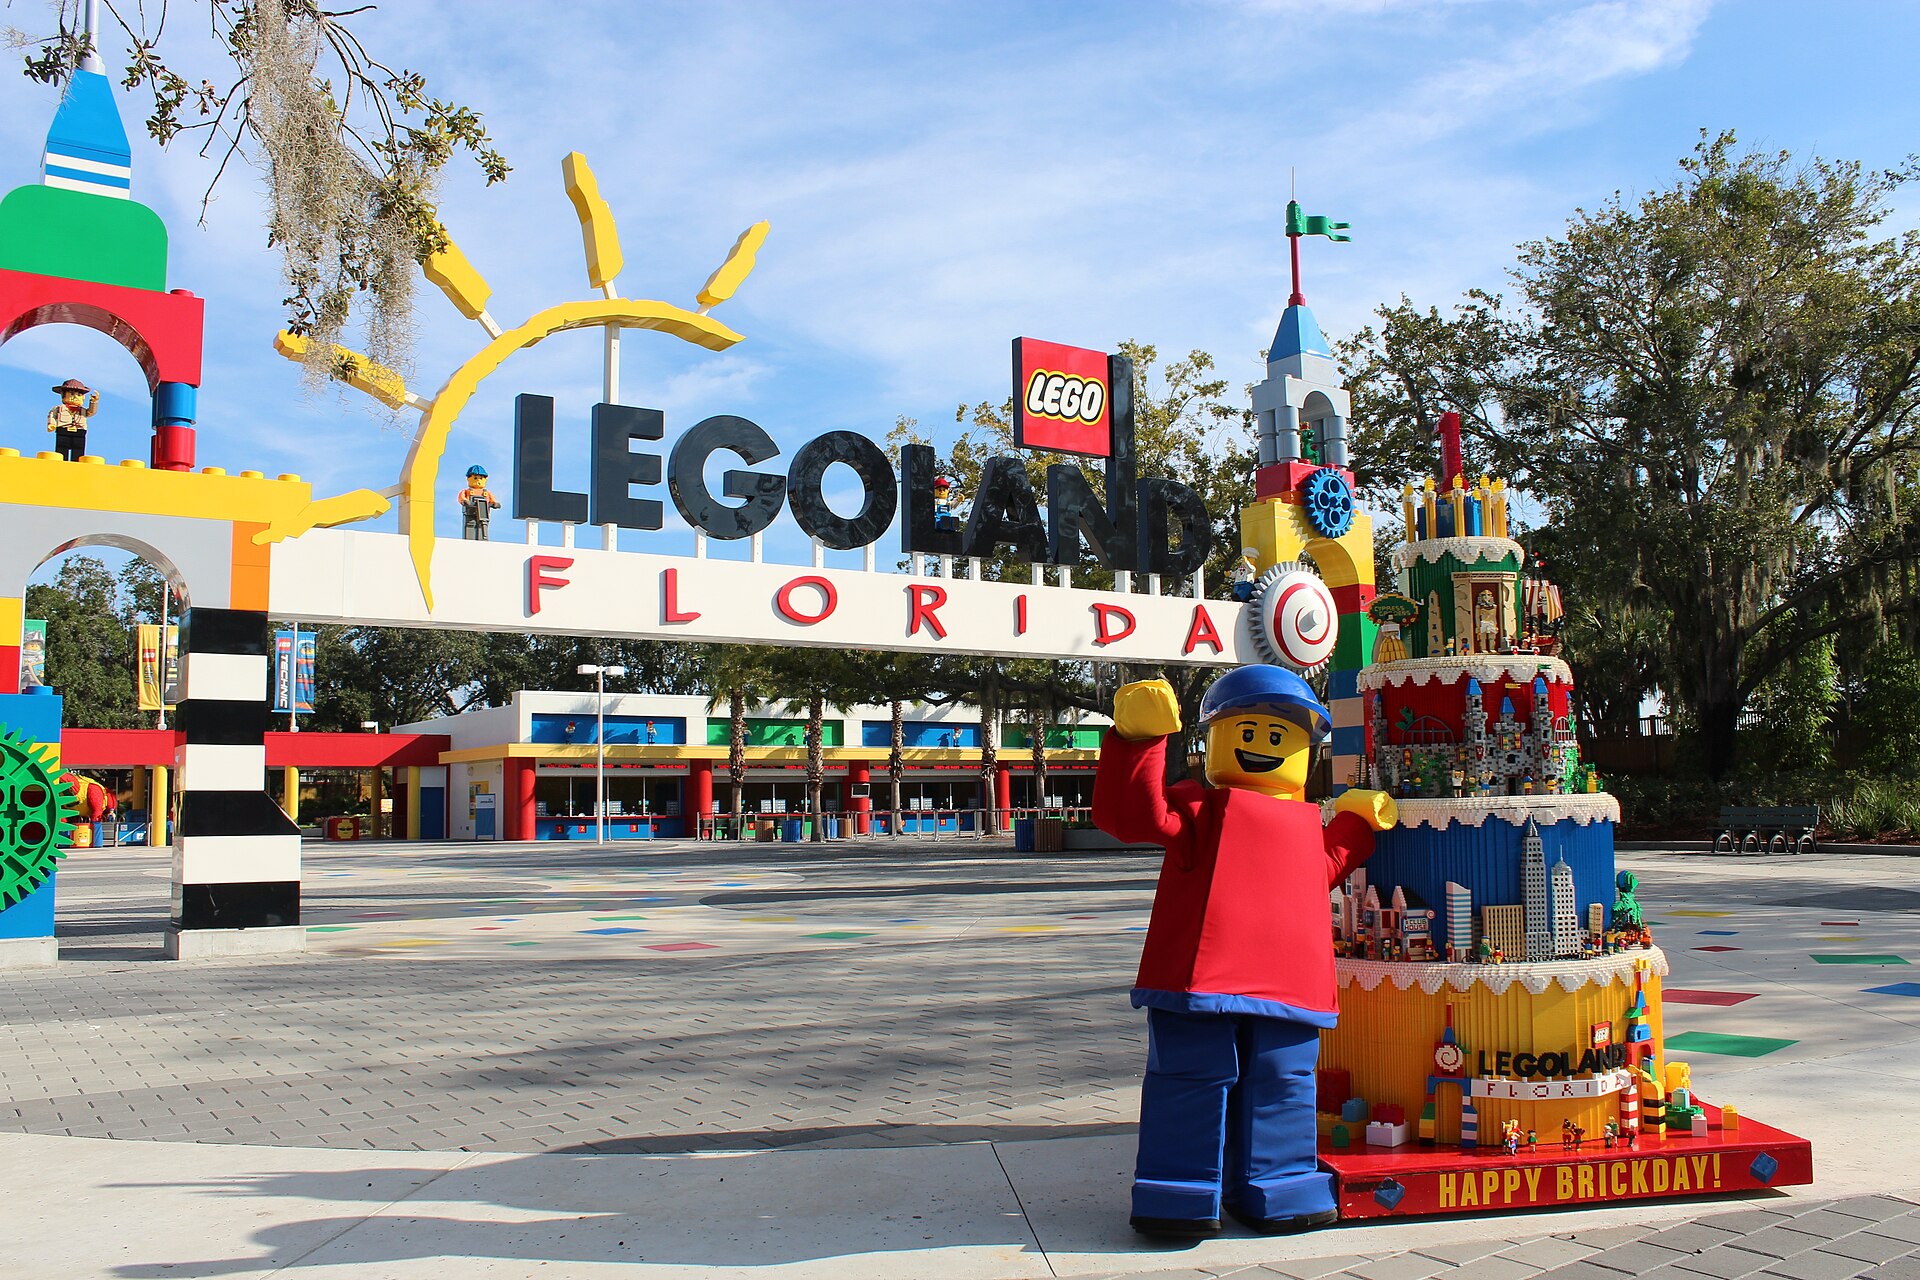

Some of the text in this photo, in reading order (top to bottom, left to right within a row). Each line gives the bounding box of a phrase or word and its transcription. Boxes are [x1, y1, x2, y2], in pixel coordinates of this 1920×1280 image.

[1027, 371, 1105, 423] LEGO
[512, 354, 1212, 577] LEGOLAND
[529, 554, 1224, 655] FLORIDA
[280, 654, 289, 709] TECHNIC
[1478, 1043, 1626, 1077] LEGOLAND
[1487, 1075, 1625, 1097] FLORIDA
[1439, 1153, 1721, 1208] HAPPY BRICKDAY!
